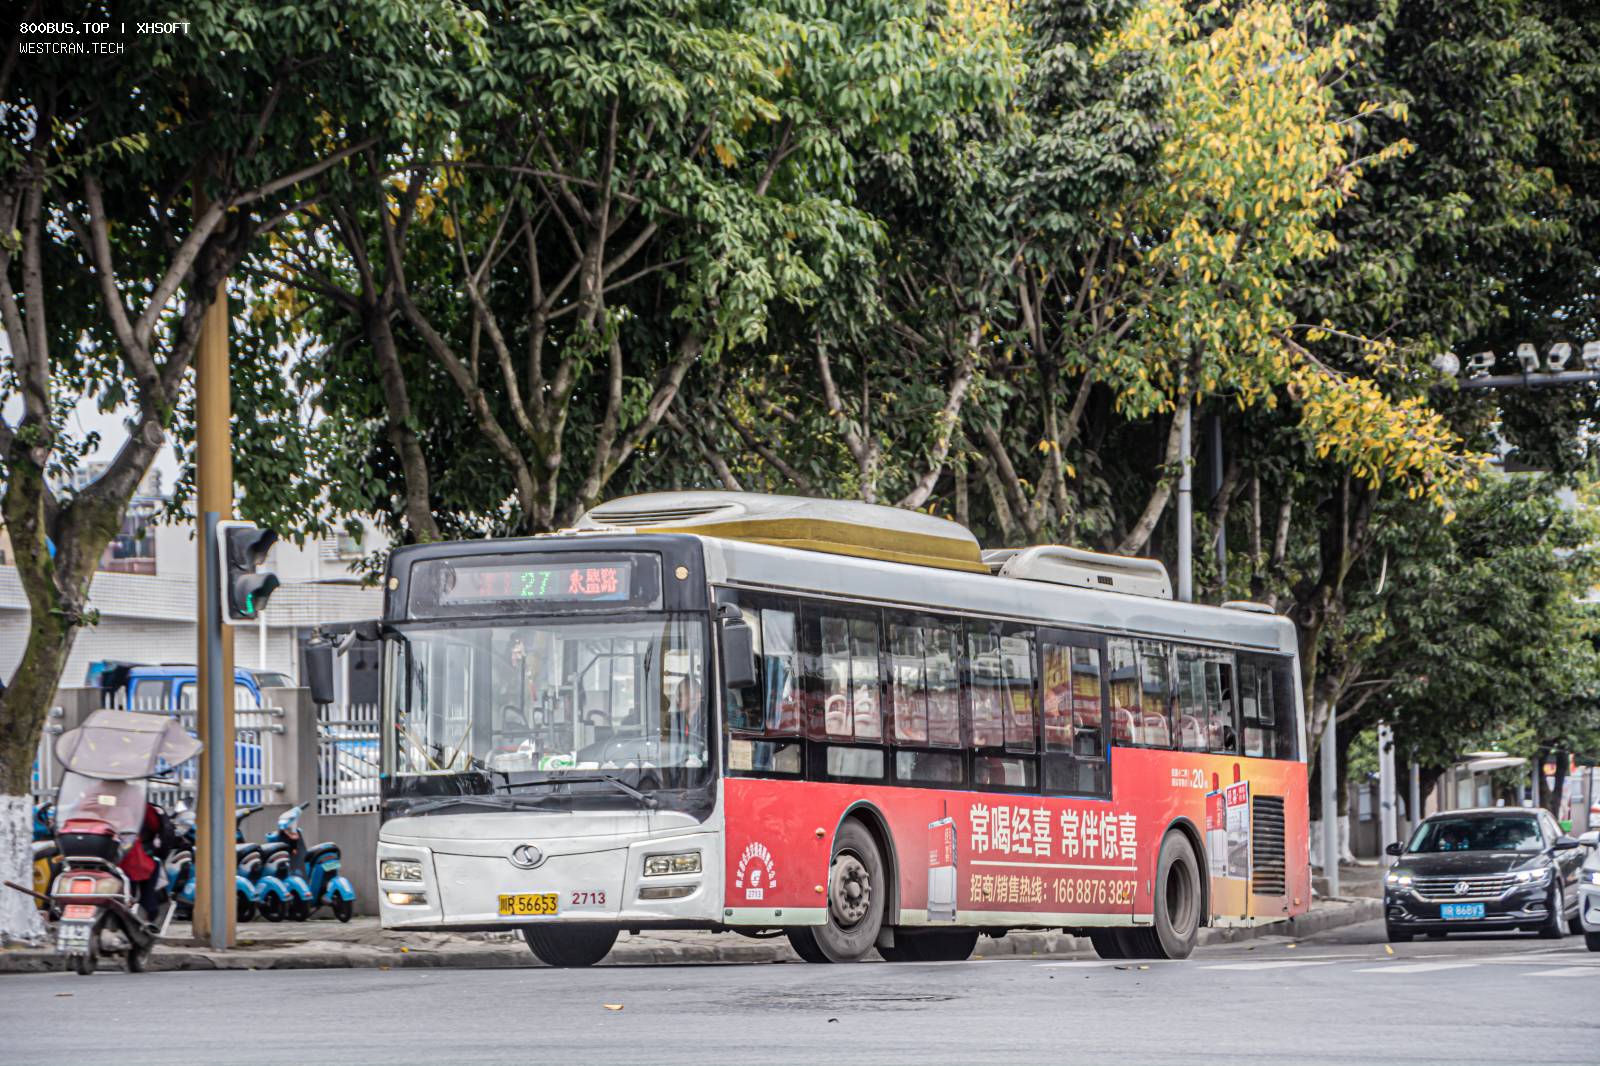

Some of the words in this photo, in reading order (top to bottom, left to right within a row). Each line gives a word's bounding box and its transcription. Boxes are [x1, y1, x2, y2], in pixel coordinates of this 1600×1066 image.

[520, 571, 551, 596] 27
[969, 803, 1052, 857] 常喝经喜
[1060, 808, 1138, 860] 常伴惊喜
[572, 892, 606, 905] 2713
